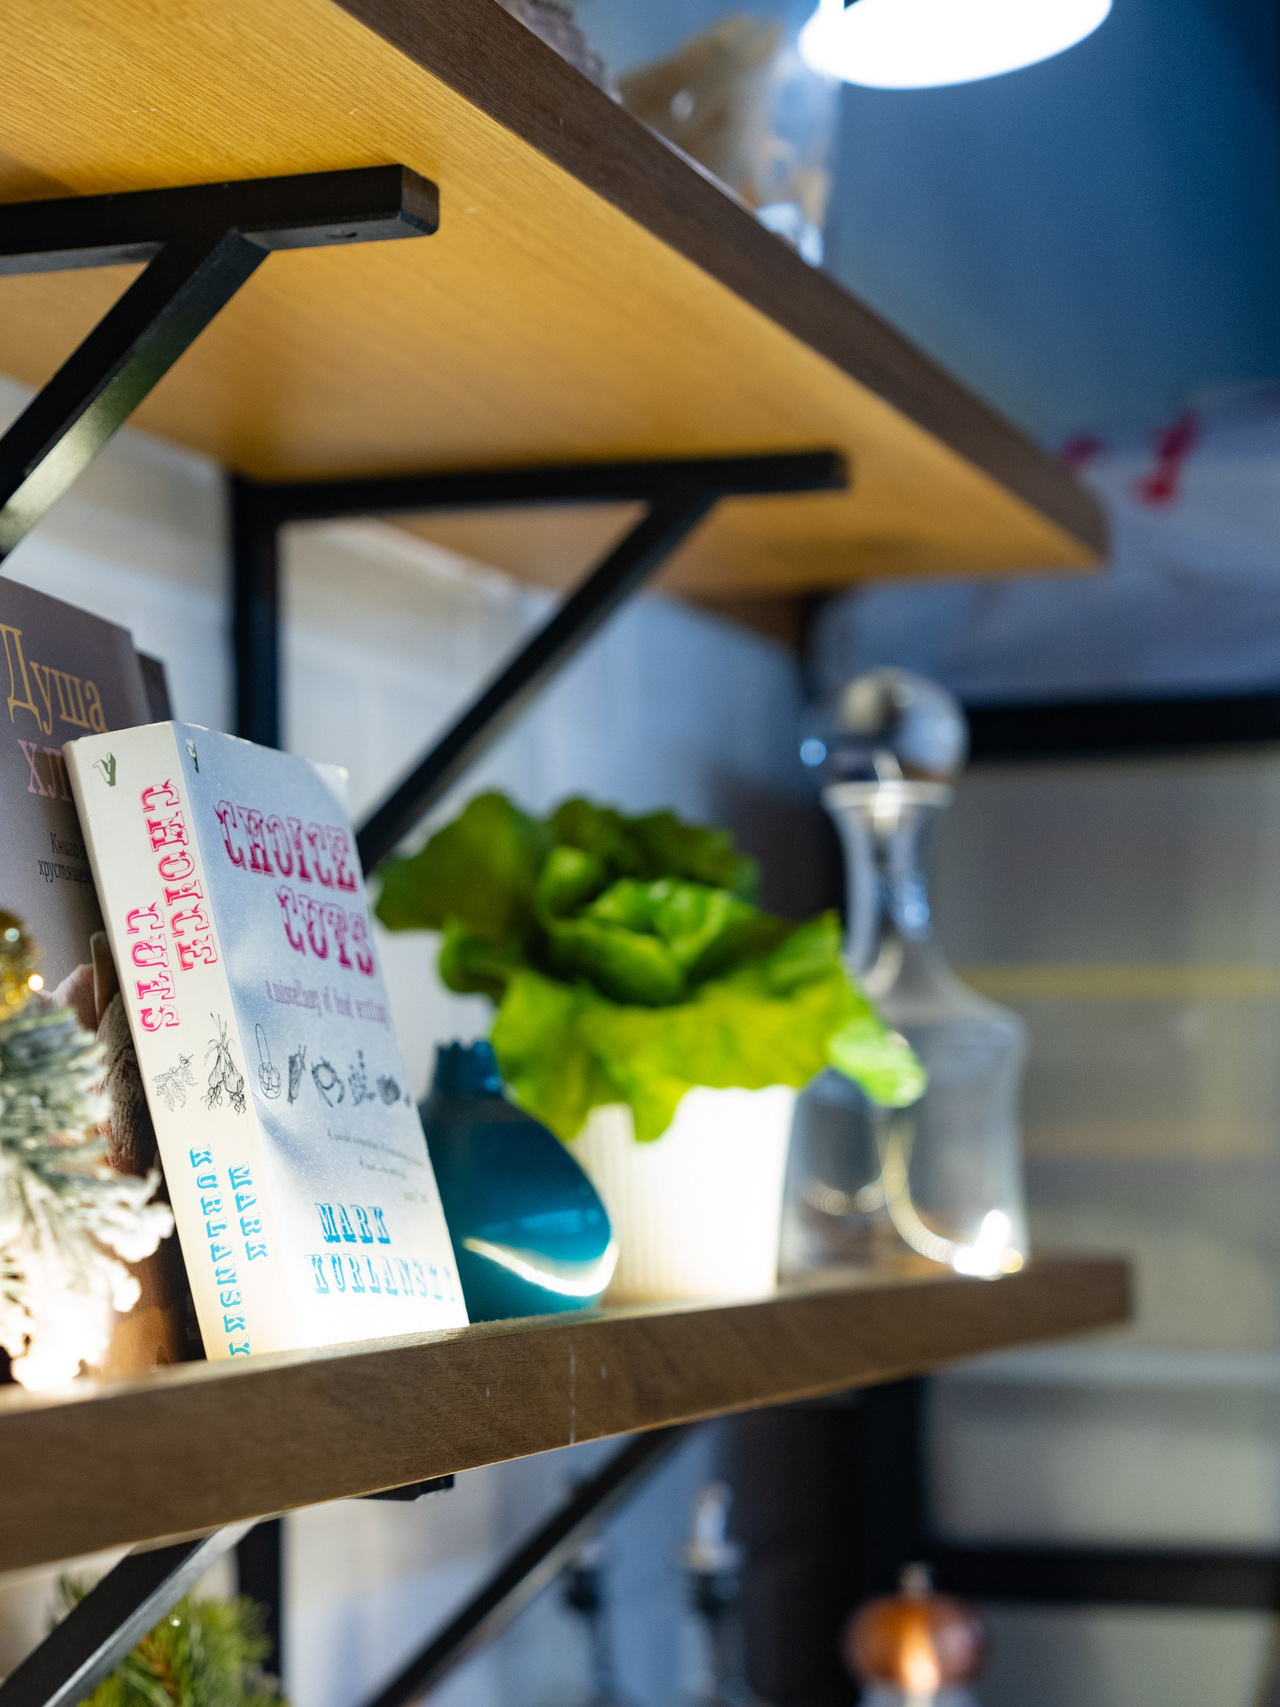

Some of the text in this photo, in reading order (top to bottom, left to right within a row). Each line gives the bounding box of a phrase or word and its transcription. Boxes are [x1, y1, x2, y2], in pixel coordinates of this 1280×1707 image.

[49, 832, 80, 859] Книга
[140, 777, 220, 973] CHOICE
[212, 796, 360, 894] CHOICE
[125, 900, 180, 1033] CUTS
[278, 884, 376, 978] CUTS
[189, 1142, 252, 1357] KURLANSKY
[228, 1161, 269, 1262] MARK
[314, 1201, 393, 1245] MARK
